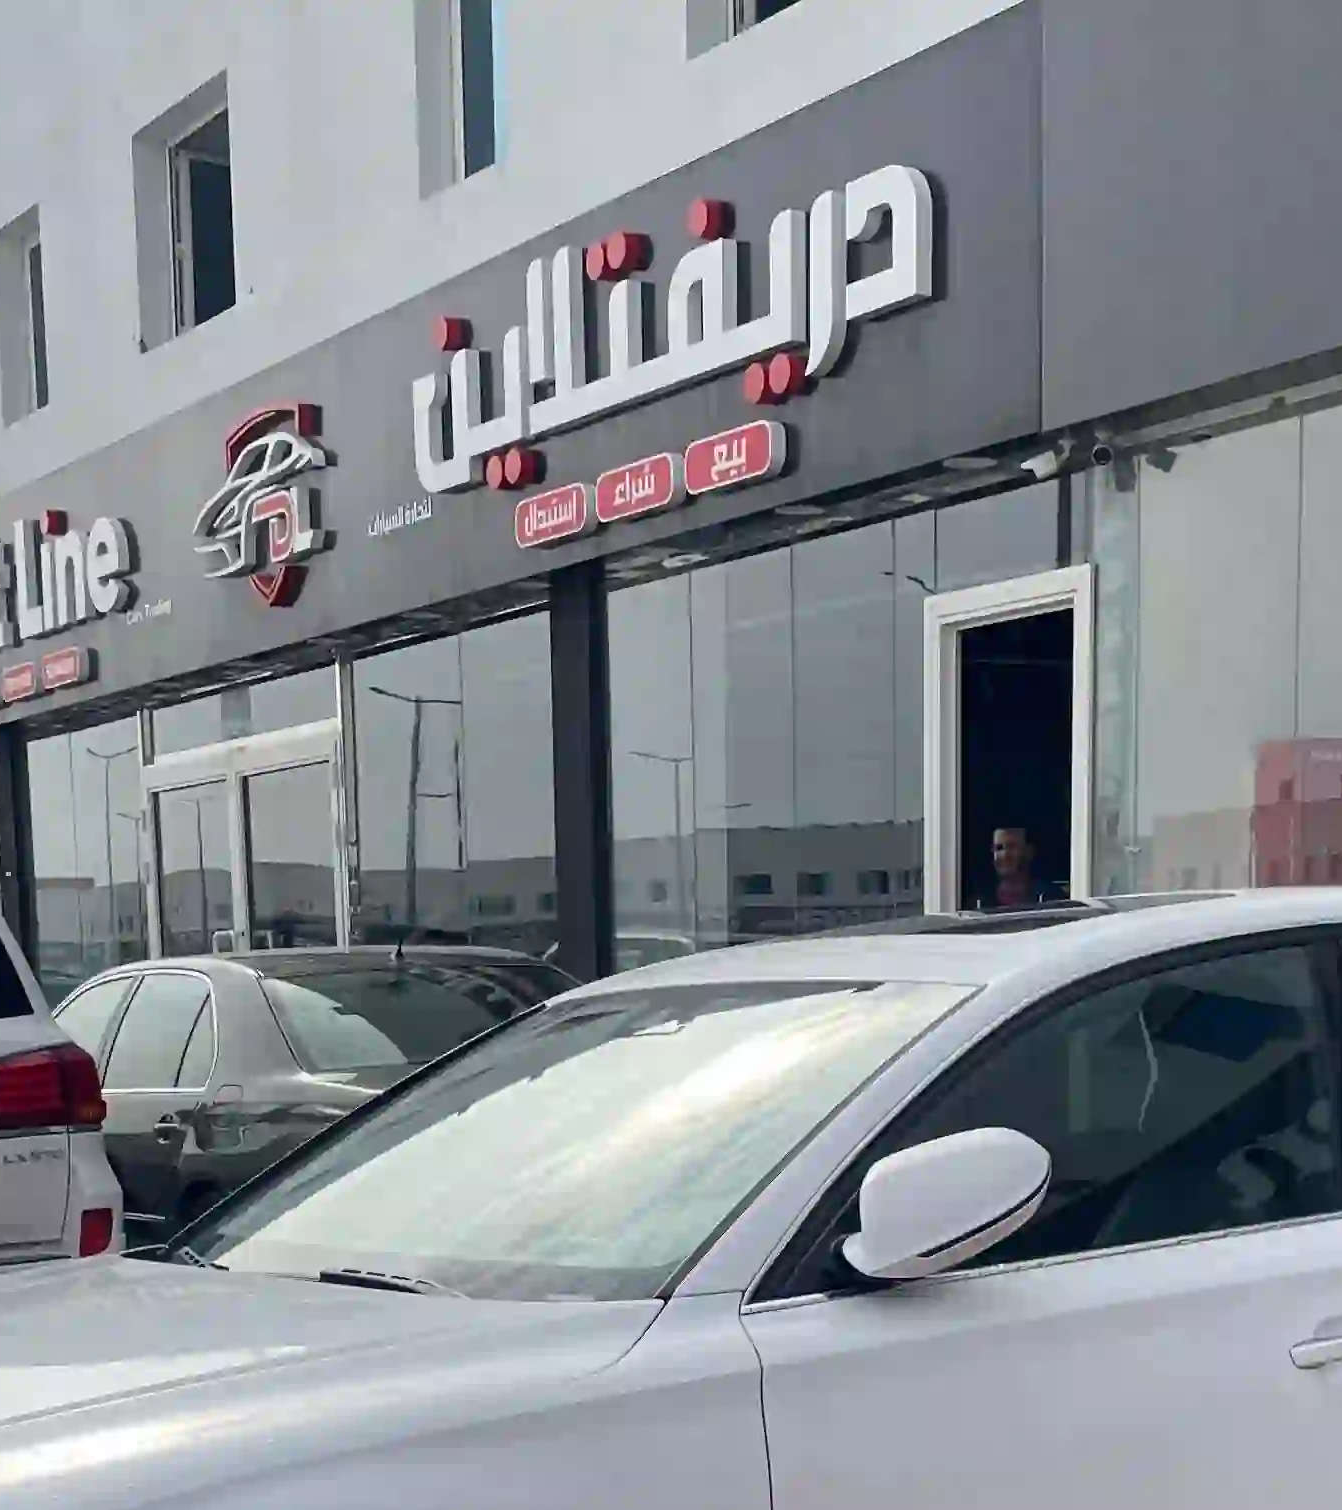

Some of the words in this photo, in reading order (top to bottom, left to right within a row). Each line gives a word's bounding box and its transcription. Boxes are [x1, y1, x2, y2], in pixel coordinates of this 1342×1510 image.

[710, 436, 747, 482] بيع
[612, 464, 655, 507] شراء
[524, 490, 578, 537] استبدال
[13, 509, 131, 640] Line
